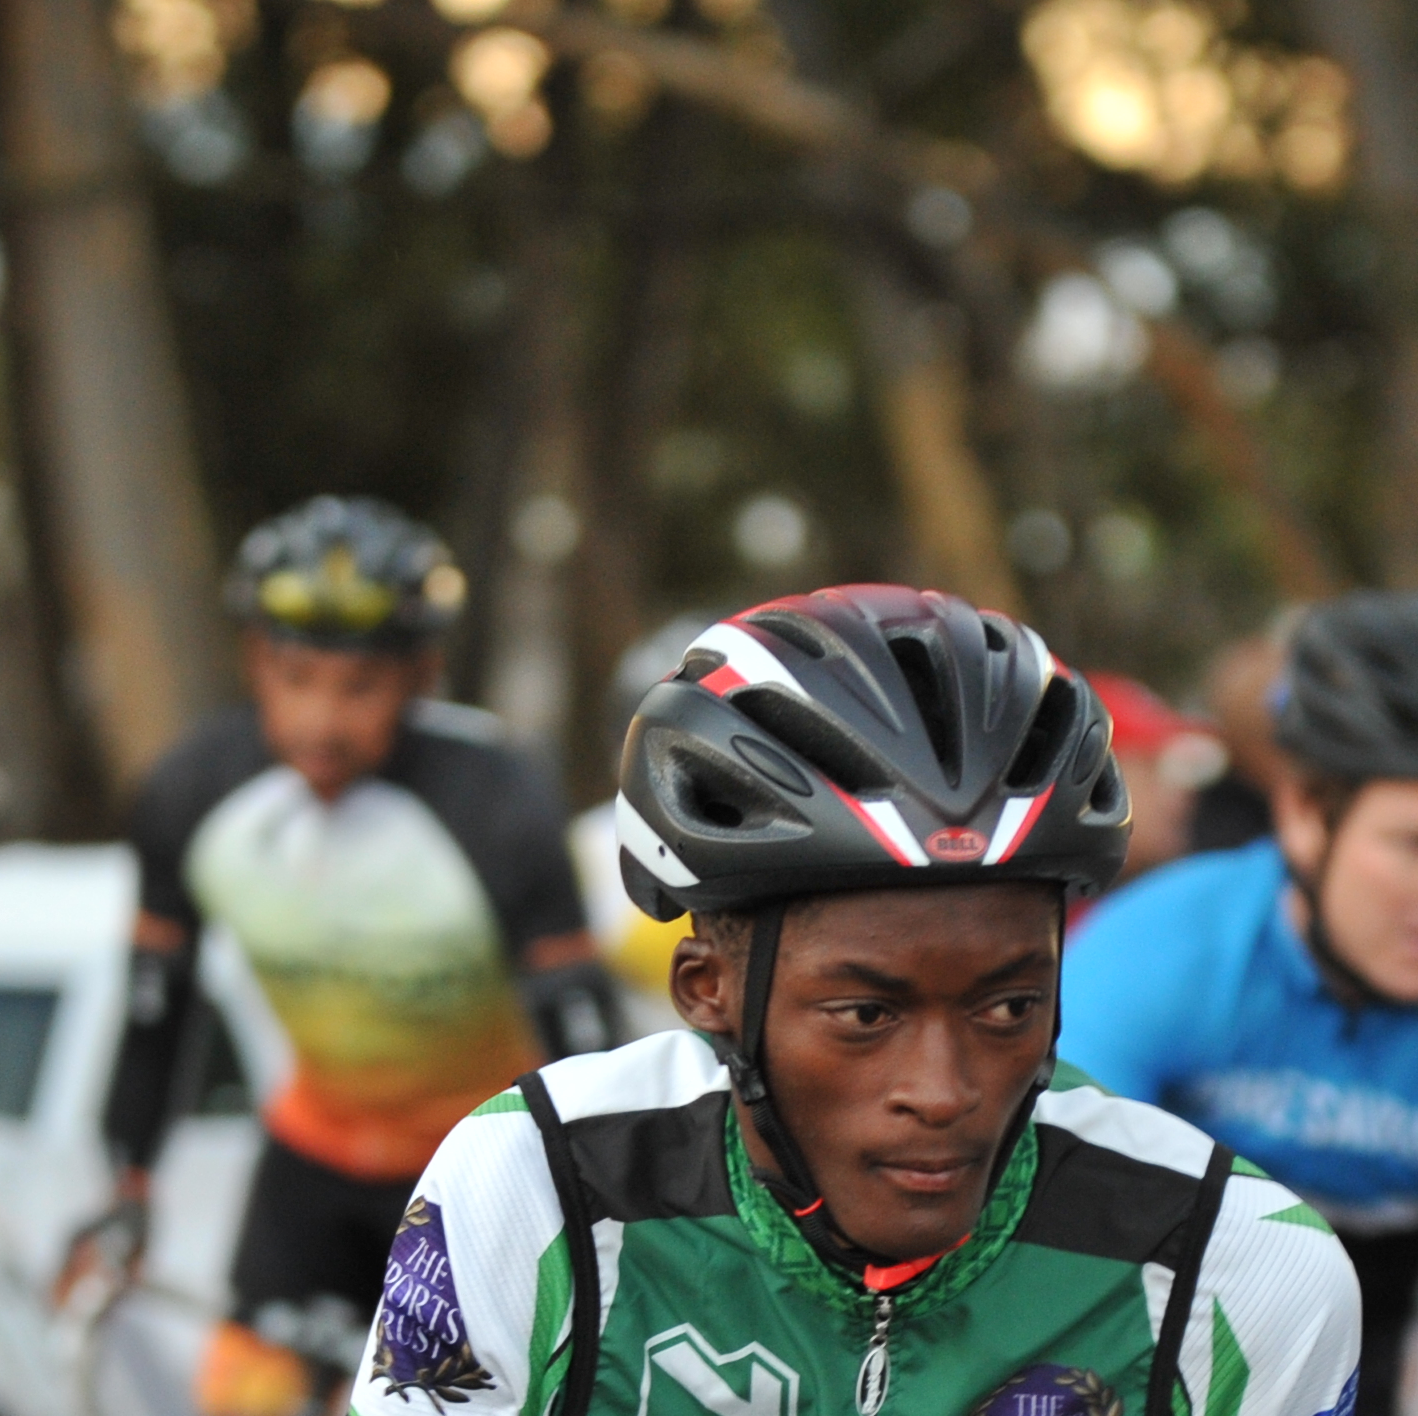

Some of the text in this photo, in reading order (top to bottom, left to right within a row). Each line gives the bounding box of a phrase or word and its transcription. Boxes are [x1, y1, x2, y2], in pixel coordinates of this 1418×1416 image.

[937, 836, 980, 852] BELL
[403, 1236, 449, 1290] THE
[384, 1258, 460, 1346] PORTS
[380, 1307, 442, 1360] RUST
